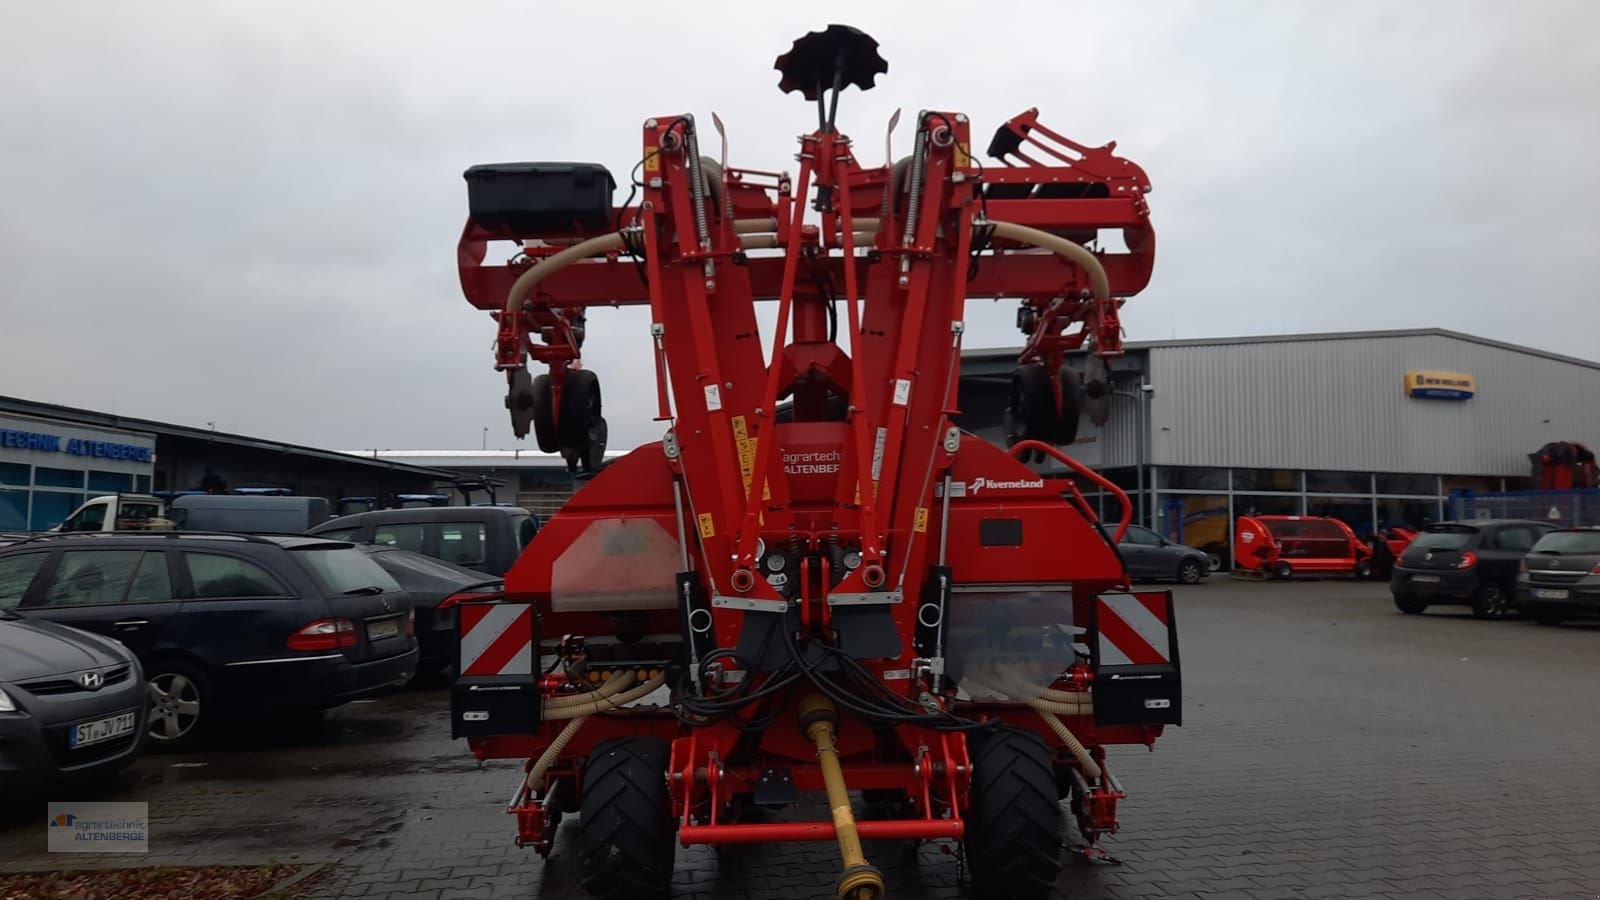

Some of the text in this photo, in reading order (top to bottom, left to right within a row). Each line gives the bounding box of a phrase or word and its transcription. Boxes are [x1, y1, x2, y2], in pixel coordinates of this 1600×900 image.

[68, 438, 151, 463] ALTENBERGE
[783, 450, 841, 464] agrartech
[986, 479, 1044, 489] Kverneland
[79, 724, 94, 742] ST
